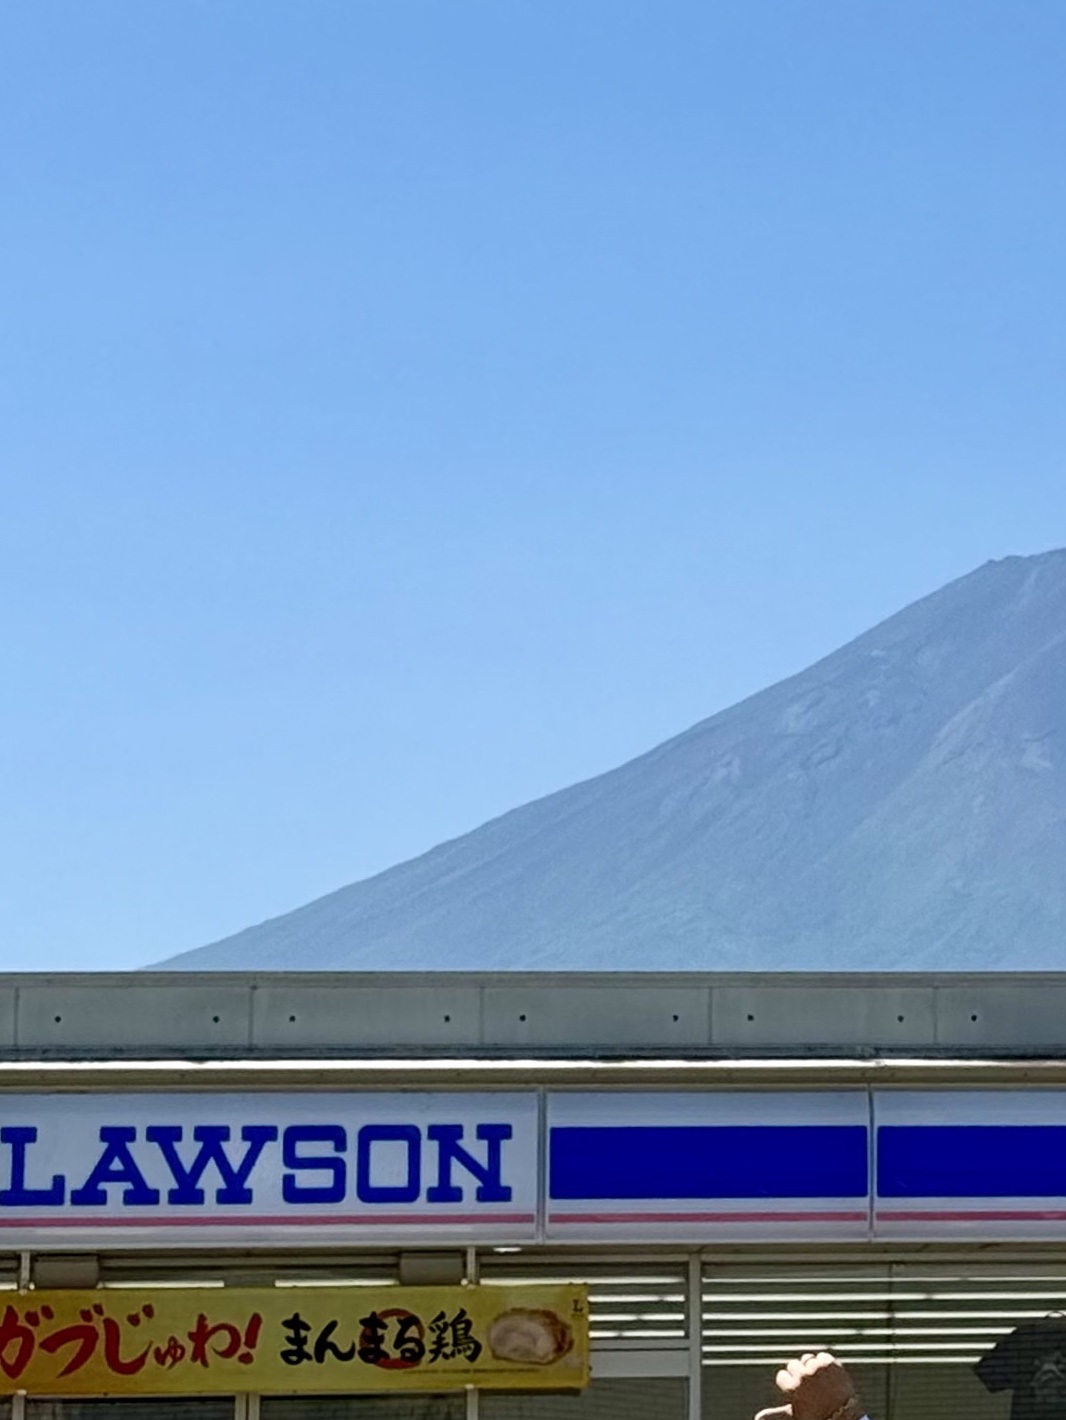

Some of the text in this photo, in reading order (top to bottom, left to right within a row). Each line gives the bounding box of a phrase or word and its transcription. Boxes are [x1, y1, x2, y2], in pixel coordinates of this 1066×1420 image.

[0, 1124, 512, 1206] LAWSON
[280, 1308, 482, 1365] まんまる鶏
